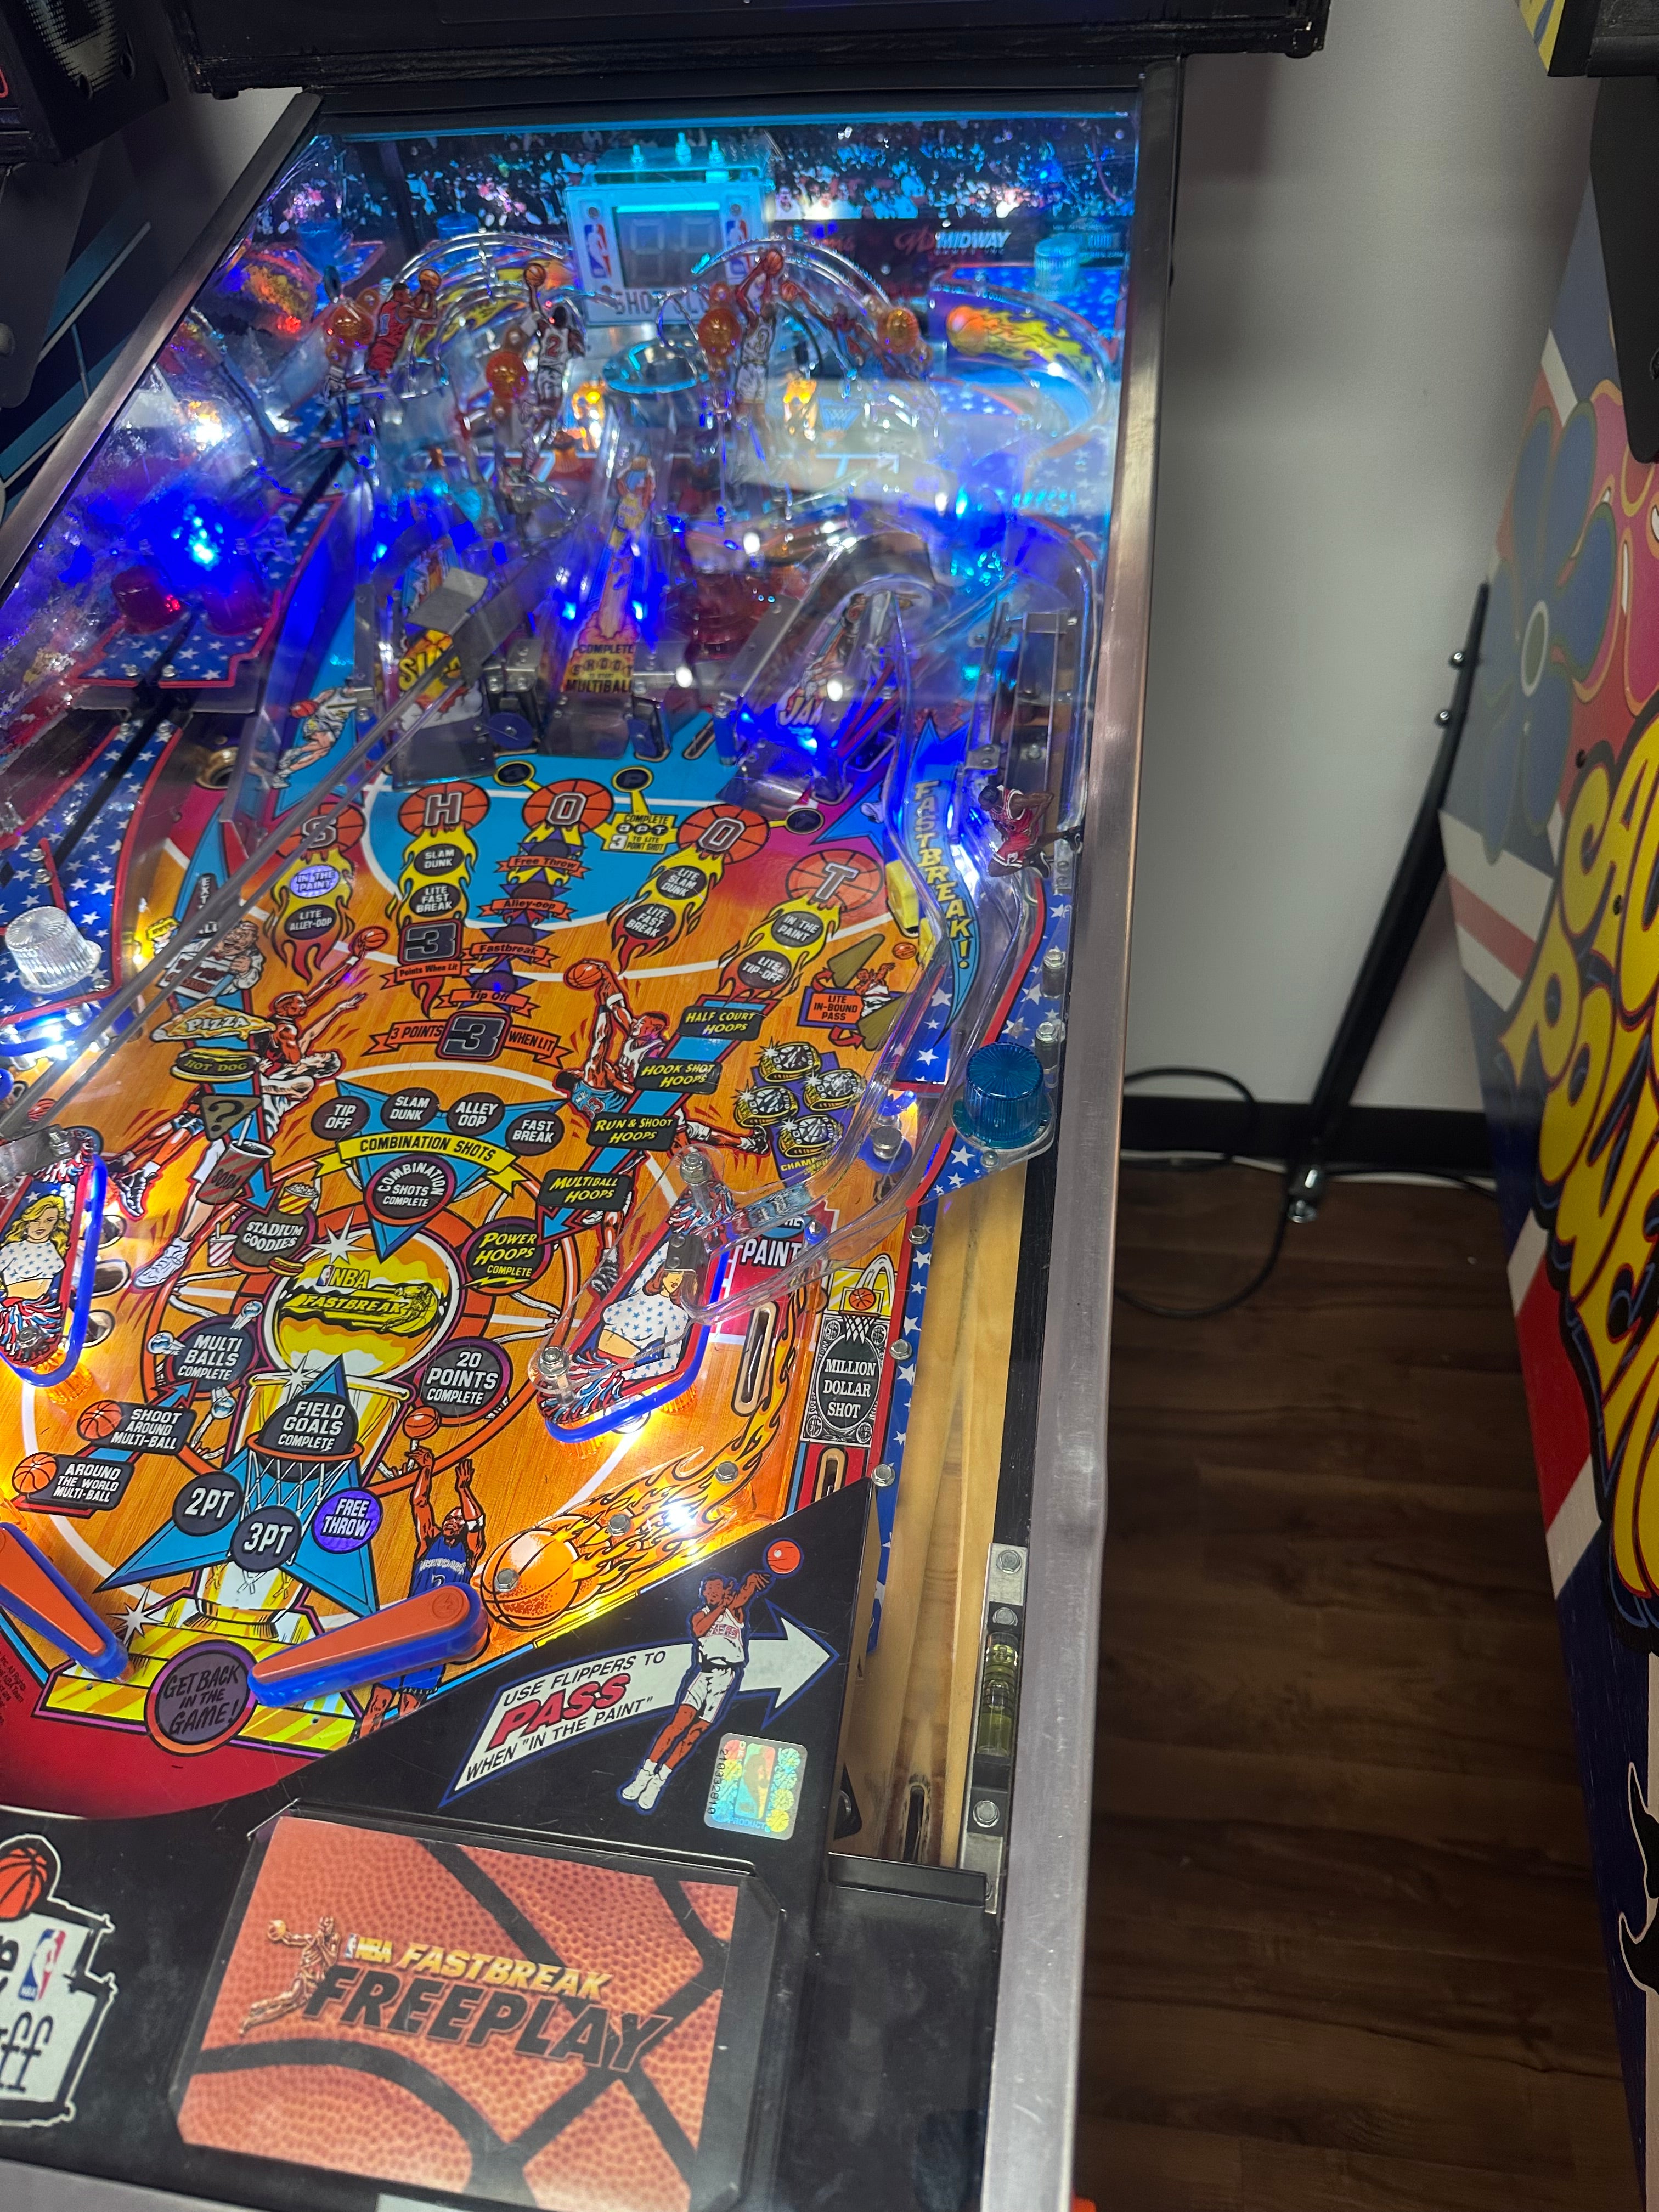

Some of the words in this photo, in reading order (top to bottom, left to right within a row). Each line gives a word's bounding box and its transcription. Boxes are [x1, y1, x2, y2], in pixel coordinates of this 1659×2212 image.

[935, 230, 1011, 249] MIDWAY
[579, 644, 634, 654] COMPLETE
[624, 814, 669, 824] COMPLETE
[609, 834, 629, 850] 3
[627, 842, 646, 851] POINT
[646, 843, 665, 851] SHOT
[424, 849, 455, 860] SLAM
[424, 858, 453, 868] DUNK
[514, 857, 541, 867] Free
[543, 857, 577, 870] Throw
[295, 873, 311, 884] IN
[314, 870, 335, 881] THE
[669, 874, 697, 889] SLAM
[678, 867, 700, 881] LITE
[298, 879, 331, 892] PAINT
[425, 885, 448, 896] LITE
[660, 882, 689, 898] DUNK
[416, 901, 453, 912] BREAK
[421, 893, 449, 904] FAST
[503, 900, 556, 911] Alley-oop
[299, 909, 323, 921] LITE
[637, 912, 665, 928] FAST
[646, 904, 670, 921] LITE
[289, 917, 332, 932] ALLEY-OOP
[625, 918, 661, 938] BREAK
[783, 915, 795, 926] IN
[798, 920, 820, 934] THE
[778, 924, 811, 943] PAINT
[403, 922, 456, 962] 3
[479, 944, 538, 956] Fastbreak
[399, 966, 424, 978] Points
[425, 964, 447, 974] When
[447, 962, 459, 972] Lit
[758, 956, 781, 971] LITE
[742, 961, 784, 983] TIP-OFF
[470, 990, 489, 1002] Tip
[490, 991, 511, 1002] Off
[828, 995, 847, 1004] LITE
[814, 1002, 857, 1013] IN-BOUND
[185, 1015, 251, 1032] PIZZA
[685, 1012, 716, 1024] HALF
[719, 1012, 757, 1022] COURT
[821, 1010, 847, 1022] PASS
[390, 1026, 399, 1040] 3
[402, 1024, 443, 1039] POINTS
[441, 1015, 505, 1058] 3
[703, 1022, 749, 1036] HOOPS
[508, 1030, 537, 1048] WHEN
[536, 1035, 556, 1052] LIT
[183, 1060, 213, 1073] HOT
[216, 1062, 248, 1073] DOG
[641, 1064, 682, 1076] HOOK
[685, 1064, 715, 1073] SHOT
[659, 1074, 708, 1088] HOOPS
[334, 1104, 357, 1116] TIP
[394, 1096, 431, 1108] SLAM
[455, 1102, 498, 1116] ALLEY
[390, 1109, 425, 1121] DUNK
[458, 1115, 487, 1128] OOP
[325, 1117, 354, 1130] OFF
[521, 1119, 554, 1131] FAST
[594, 1119, 624, 1132] RUN
[628, 1120, 637, 1129] &
[639, 1118, 674, 1128] SHOOT
[512, 1130, 556, 1143] BREAK
[609, 1130, 658, 1144] HOOPS
[359, 1136, 452, 1152] COMBINATION
[453, 1139, 497, 1162] SHOTS
[210, 1167, 243, 1189] SODA
[377, 1162, 447, 1197] COMBINATION
[549, 1176, 618, 1192] MULTIBALL
[391, 1184, 430, 1197] SHOTS
[564, 1189, 616, 1203] HOOPS
[382, 1195, 430, 1207] COMPLETE
[245, 1221, 304, 1238] STADIUM
[241, 1233, 299, 1253] GOODIES
[480, 1231, 538, 1246] POWER
[474, 1245, 536, 1266] HOOPS
[741, 1238, 803, 1267] PAINT
[328, 1268, 371, 1289] NBA
[486, 1264, 533, 1278] COMPLETE
[301, 1295, 407, 1315] FASTBREAK
[193, 1334, 244, 1353] MULTI
[184, 1350, 240, 1367] BALLS
[456, 1351, 482, 1368] 20
[177, 1365, 233, 1381] COMPLETE
[825, 1358, 877, 1377] MILLION
[425, 1366, 499, 1390] POINTS
[823, 1379, 871, 1397] DOLLAR
[425, 1387, 484, 1406] COMPLETE
[130, 1408, 183, 1424] SHOOT
[294, 1400, 346, 1419] FIELD
[827, 1402, 861, 1419] SHOT
[124, 1421, 174, 1436] AROUND
[282, 1416, 345, 1436] GOALS
[110, 1432, 177, 1450] MULTI-BALL
[276, 1434, 336, 1452] COMPLETE
[65, 1463, 122, 1480] AROUND
[58, 1475, 77, 1486] THE
[82, 1477, 119, 1492] WORLD
[53, 1485, 111, 1503] MULTI-BALL
[184, 1487, 236, 1519] 2PT
[335, 1499, 370, 1517] FREE
[321, 1515, 373, 1537] THROW
[242, 1522, 294, 1556] 3PT
[163, 1674, 198, 1700] GET
[198, 1662, 240, 1686] BACK
[503, 1679, 547, 1707] USE
[551, 1654, 636, 1690] FLIPPERS
[644, 1649, 667, 1667] TO
[179, 1693, 197, 1709] IN
[201, 1688, 226, 1703] THE
[169, 1702, 240, 1735] GAME!
[486, 1673, 631, 1752] PASS
[465, 1743, 520, 1783] WHEN
[551, 1716, 588, 1742] THE
[727, 1816, 765, 1830] PRODUCT
[356, 1936, 392, 1965] NBA
[398, 1942, 613, 2001] FASTBREAK
[301, 1965, 673, 2073] FREEPLAY
